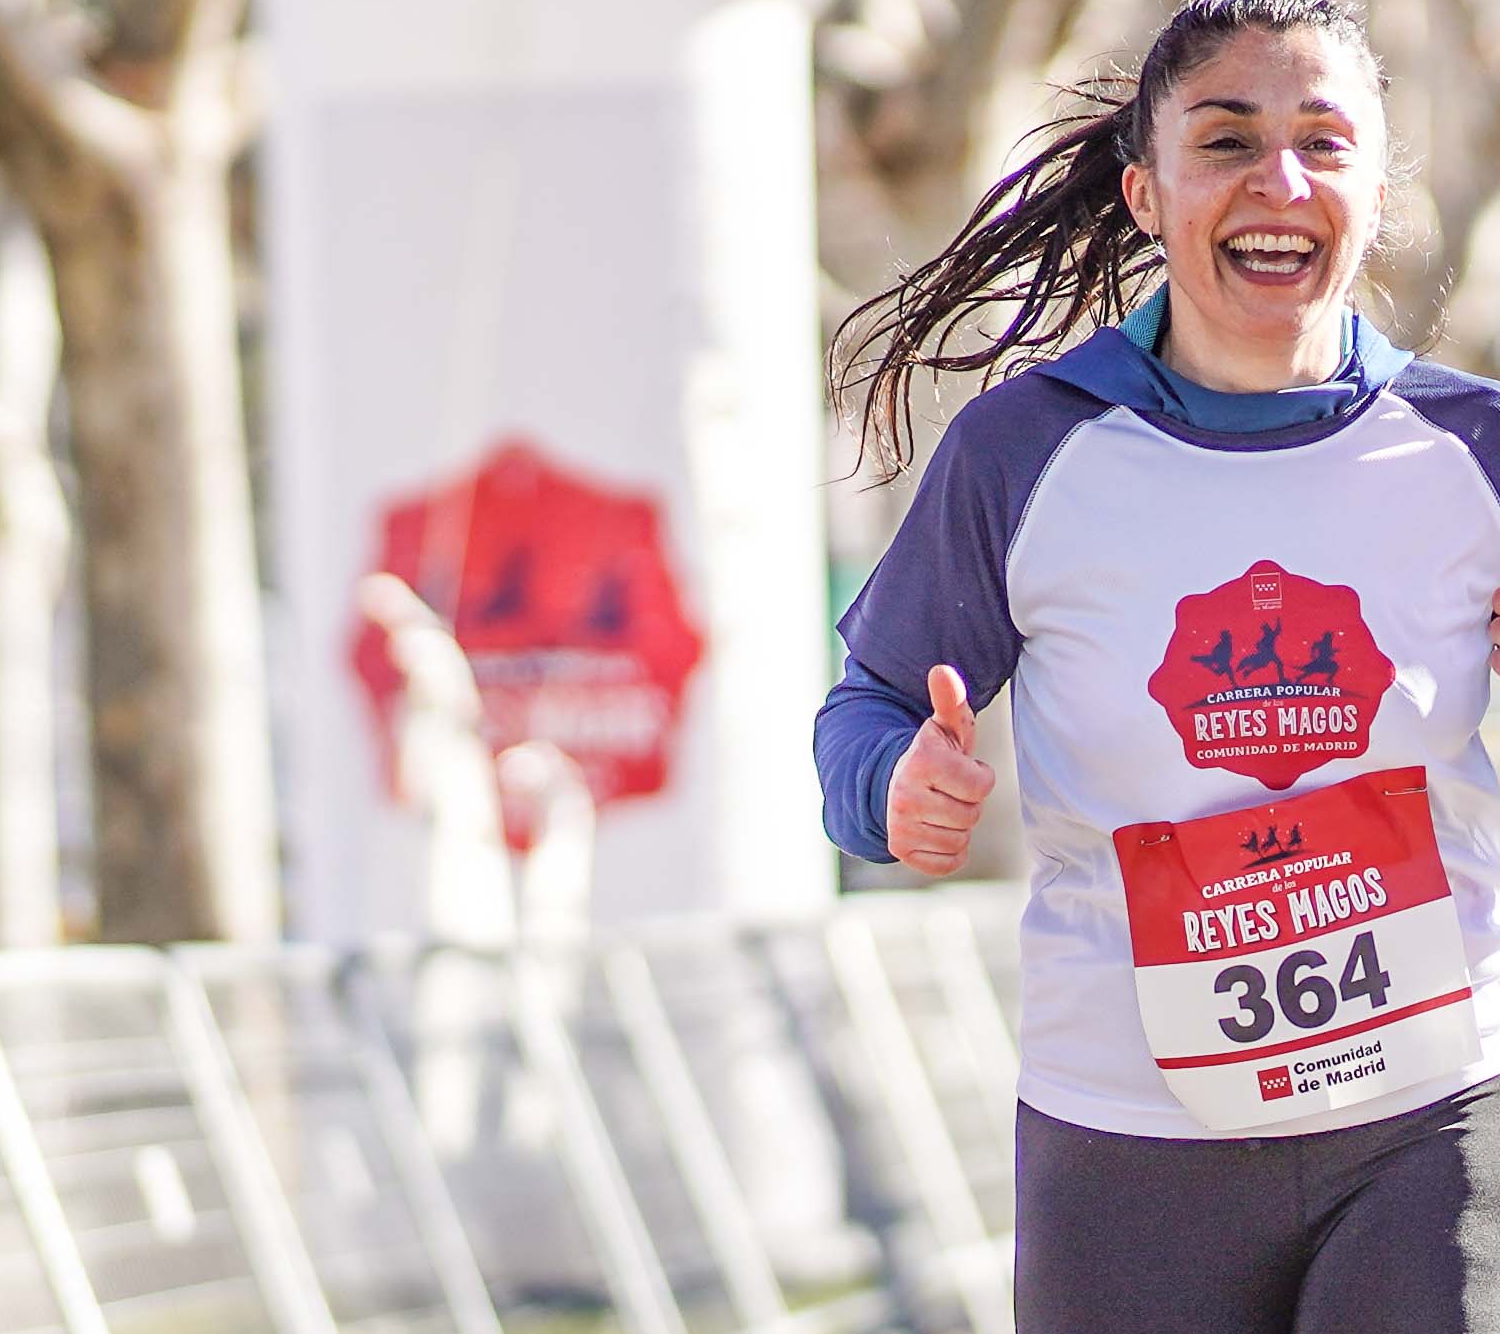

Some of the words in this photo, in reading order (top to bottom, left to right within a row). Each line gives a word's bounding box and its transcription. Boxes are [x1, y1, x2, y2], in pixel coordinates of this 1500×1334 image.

[1207, 686, 1272, 704] CARRERA
[1276, 685, 1341, 697] POPULAR
[1194, 709, 1268, 742] REYES
[1277, 704, 1358, 737] MAGOS
[1196, 744, 1277, 760] COMUNIDAD
[1283, 742, 1301, 753] DE
[1304, 740, 1358, 752] MADRID
[1201, 867, 1281, 899] CARRERA
[1284, 851, 1352, 877] POPULAR
[1272, 882, 1283, 893] de
[1285, 879, 1297, 891] los
[1182, 899, 1280, 953] REYES
[1286, 867, 1388, 934] MAGOS
[1214, 930, 1391, 1043] 364
[1293, 1040, 1383, 1075] Comunidad
[1297, 1078, 1320, 1093] de
[1326, 1057, 1386, 1087] Madrid
